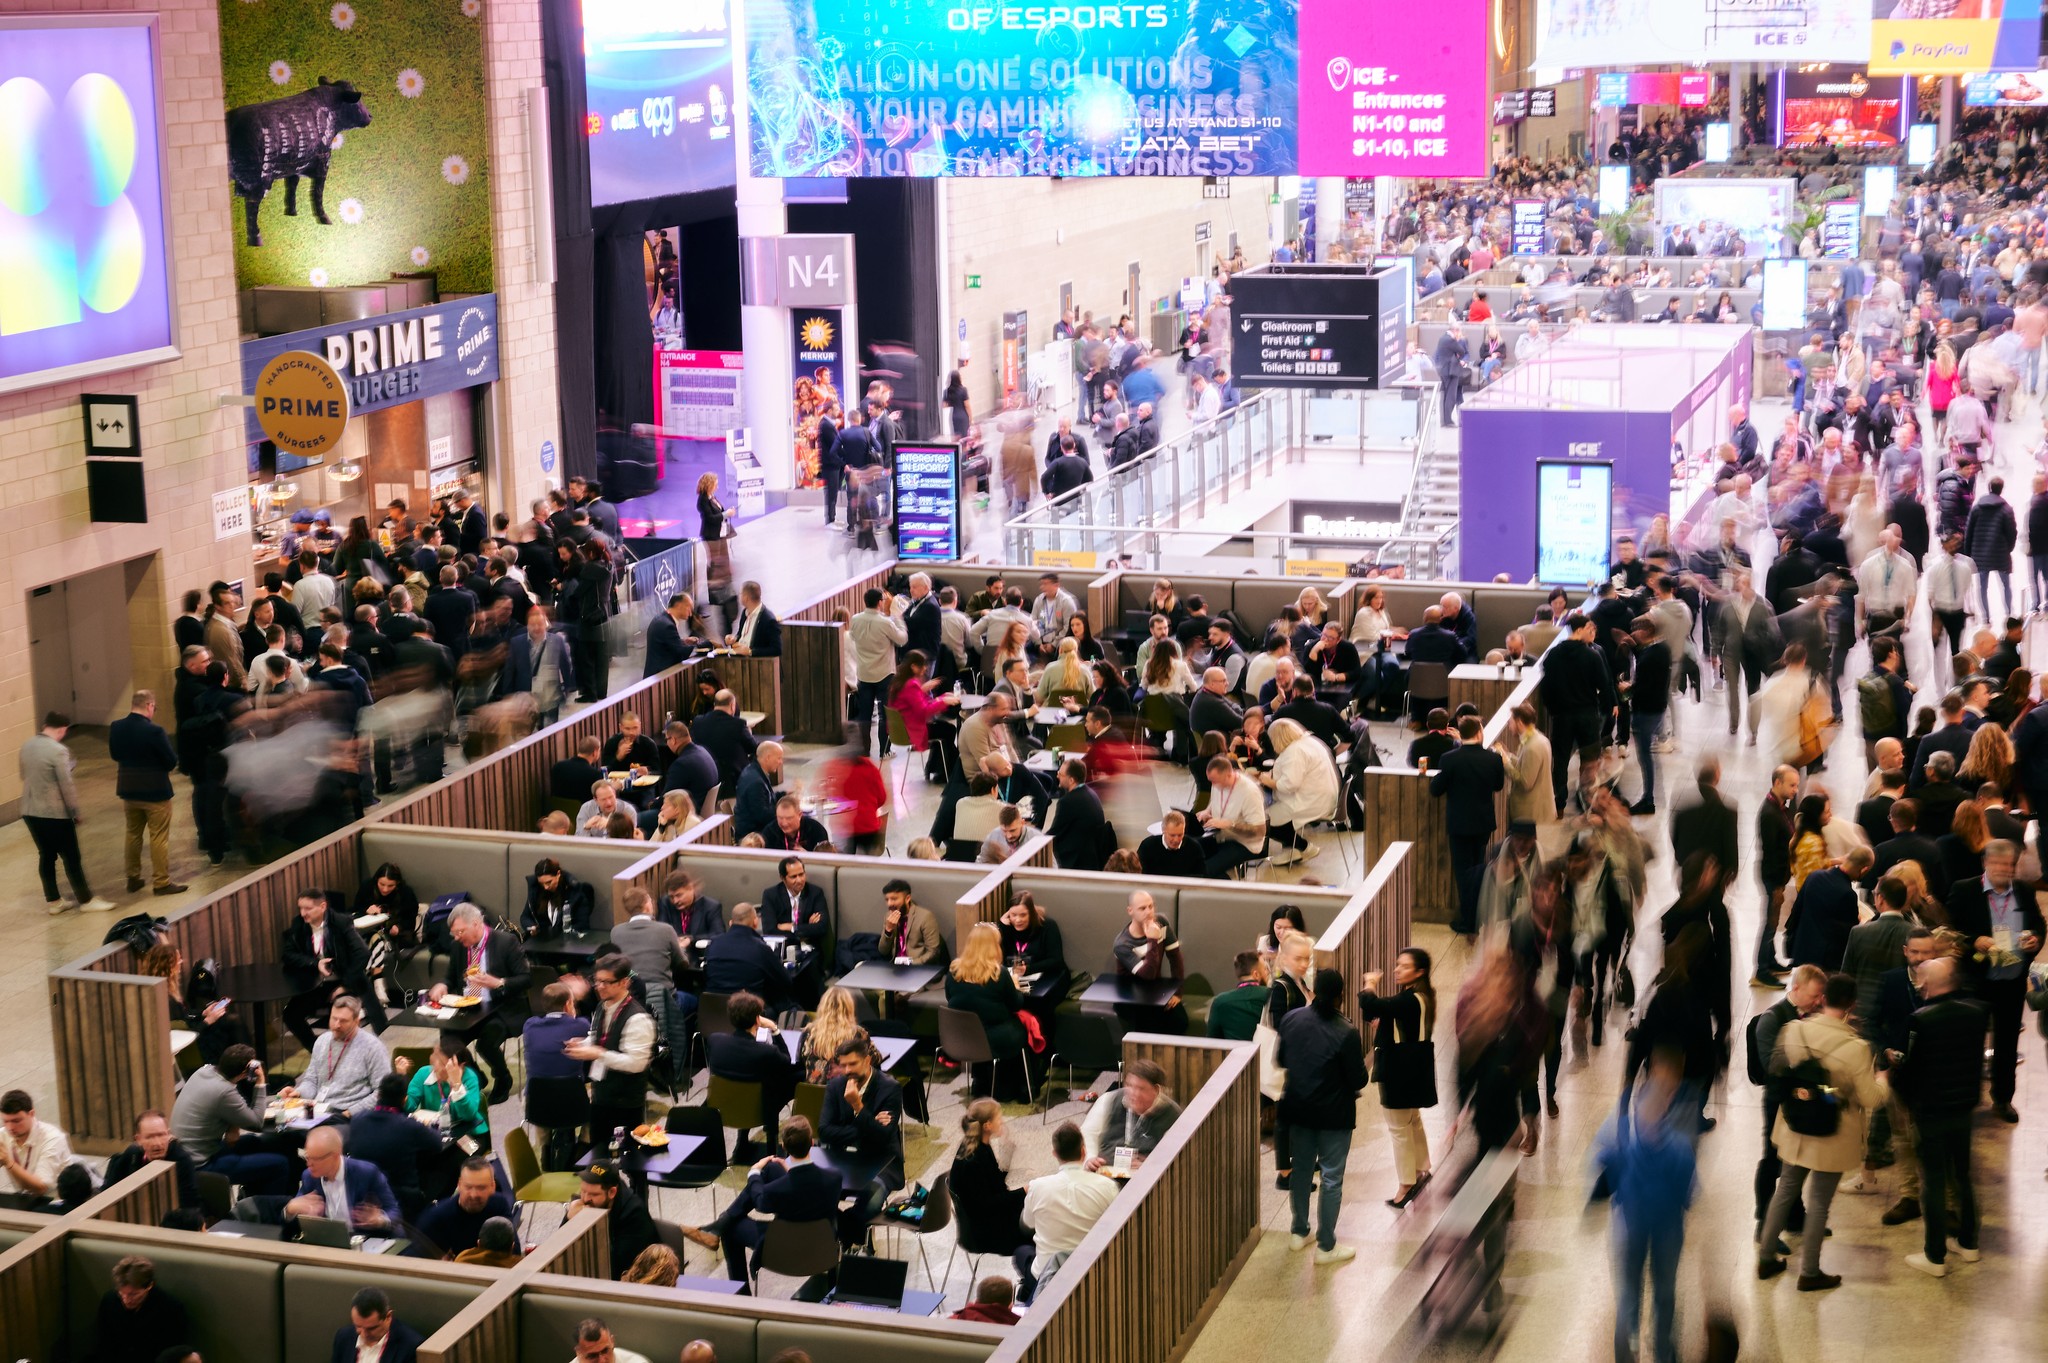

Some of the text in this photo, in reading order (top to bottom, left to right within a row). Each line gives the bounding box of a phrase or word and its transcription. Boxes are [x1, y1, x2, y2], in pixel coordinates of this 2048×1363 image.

[947, 5, 1168, 30] OF ESPORTS
[1754, 32, 1788, 46] ICE
[1912, 43, 1969, 58] PayPal
[1353, 67, 1387, 85] ICE
[1353, 91, 1447, 109] Entrances
[643, 96, 675, 138] epg
[1144, 118, 1164, 128] US
[1167, 118, 1185, 128] AT
[1188, 118, 1238, 128] STAND
[1240, 117, 1282, 128] S1-110
[1353, 114, 1445, 132] N1-10 and
[279, 122, 290, 154] RUMP
[1121, 135, 1261, 151] DATA BET
[1352, 138, 1448, 159] S1-10, ICE
[1346, 182, 1372, 191] GAMES
[787, 254, 839, 288] N4
[1261, 322, 1312, 332] Cloakroom
[325, 314, 445, 377] PRIME
[458, 325, 492, 362] PRIME
[1261, 335, 1300, 346] First Aid
[660, 352, 696, 361] ENTRANCE
[801, 351, 836, 361] MERKUR
[1261, 349, 1279, 360] Car
[1280, 349, 1307, 360] Parks
[266, 360, 333, 390] HANDCRAFTED
[1261, 362, 1292, 374] Toilets
[263, 396, 340, 418] PRIME
[277, 430, 326, 448] BURGERS
[434, 451, 448, 460] HERE
[1568, 442, 1600, 457] ICE
[214, 494, 247, 513] COLLECT
[221, 513, 243, 530] HERE
